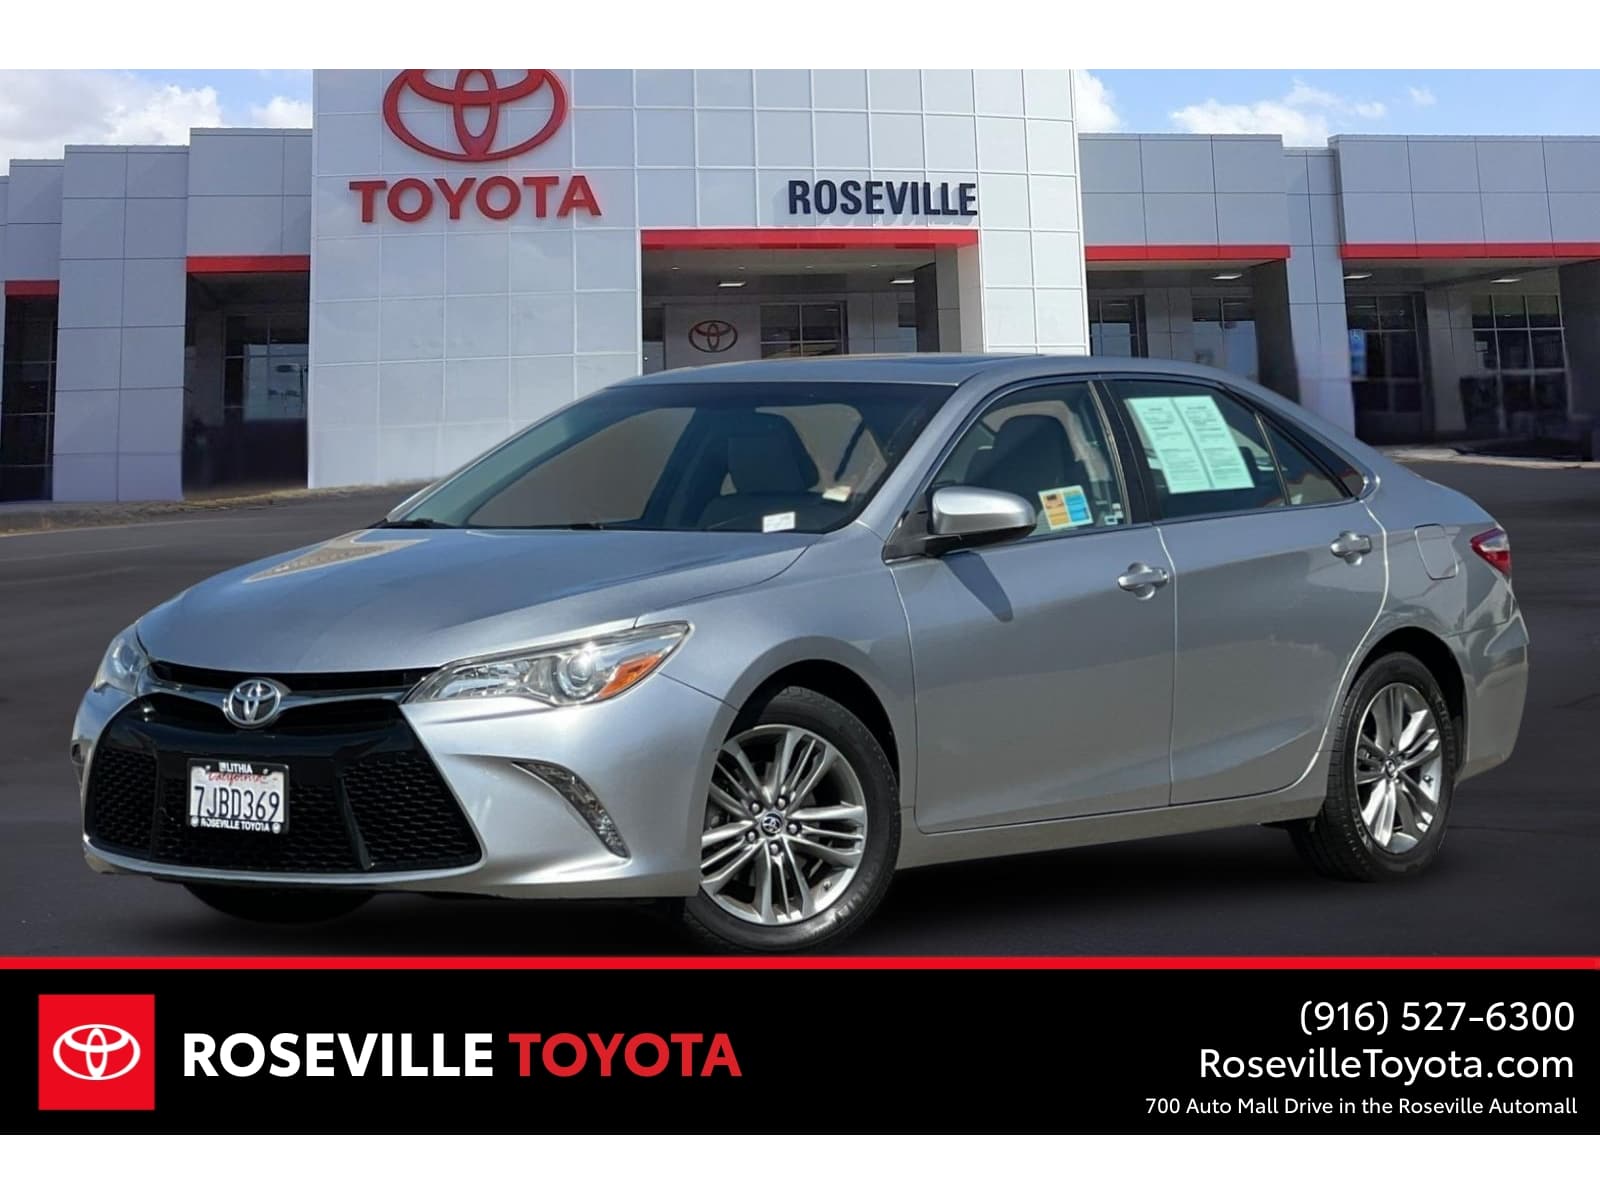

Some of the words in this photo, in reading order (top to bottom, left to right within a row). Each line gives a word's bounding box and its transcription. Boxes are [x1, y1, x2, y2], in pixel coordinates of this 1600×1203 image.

[349, 175, 602, 223] TOYOTA
[788, 179, 979, 217] ROSEVILLE
[226, 762, 253, 774] LITHIA
[194, 785, 280, 822] 7JBD369
[200, 817, 240, 830] ROSEVILLE
[241, 821, 271, 832] TOYOTA
